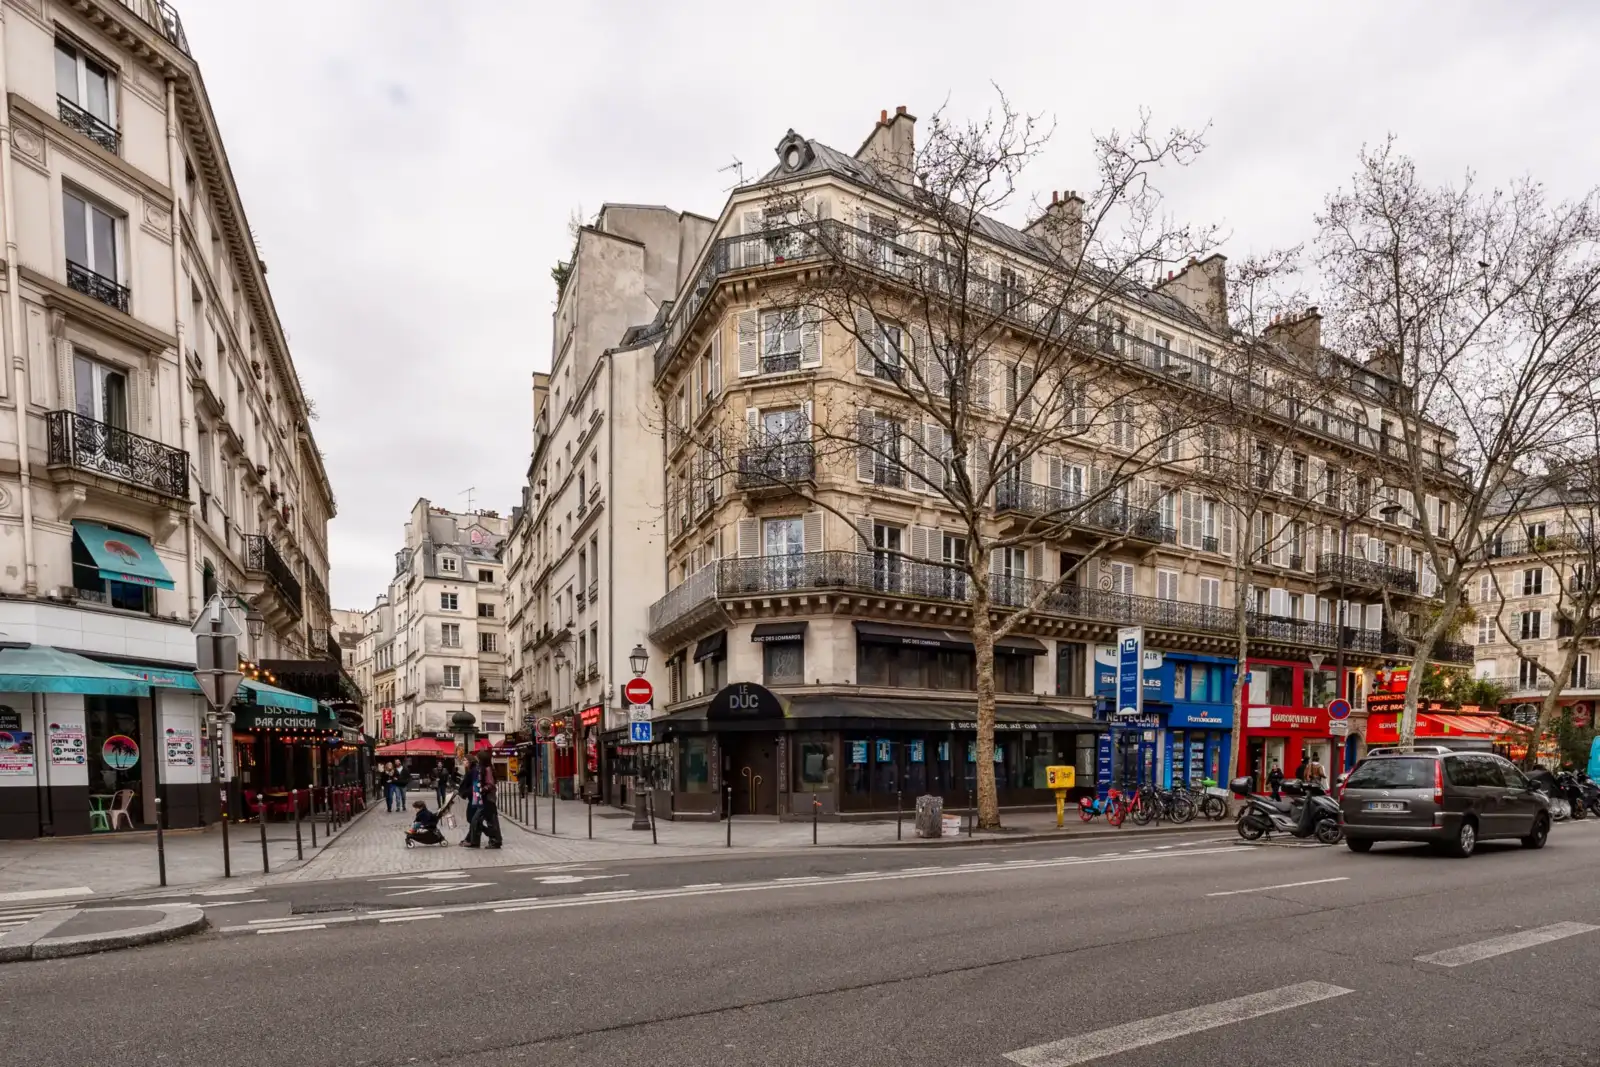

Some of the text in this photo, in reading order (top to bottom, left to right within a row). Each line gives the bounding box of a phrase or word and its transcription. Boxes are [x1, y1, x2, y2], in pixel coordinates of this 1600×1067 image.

[1106, 649, 1117, 657] NE
[740, 685, 749, 694] LE
[729, 695, 759, 709] DUC
[255, 717, 273, 726] BAR
[284, 718, 317, 727] CHICHA
